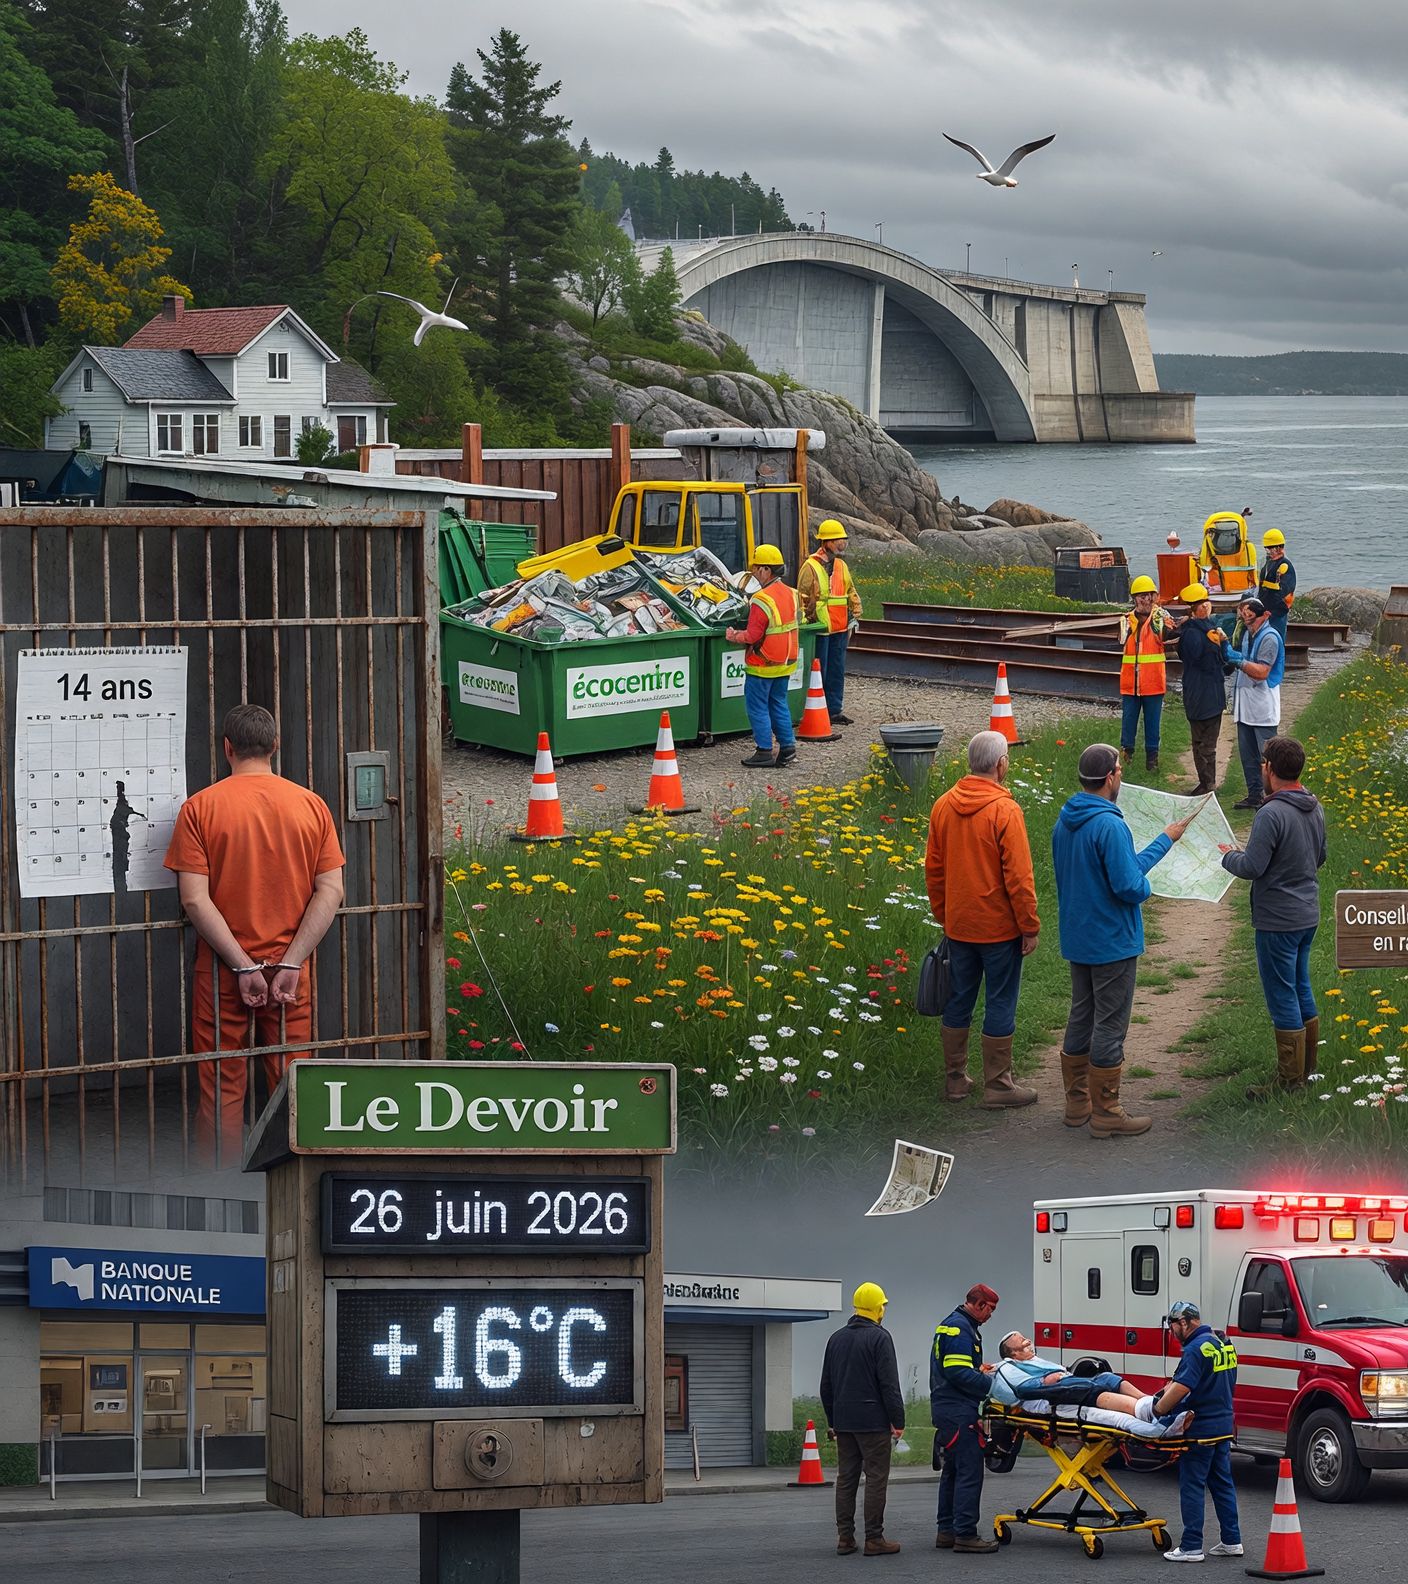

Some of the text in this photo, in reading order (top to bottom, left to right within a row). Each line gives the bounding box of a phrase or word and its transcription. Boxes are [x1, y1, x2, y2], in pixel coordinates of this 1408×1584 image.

[57, 673, 153, 701] 14 ans
[573, 664, 685, 700] écocentre
[1373, 937, 1393, 951] en
[323, 1081, 618, 1133] Le Devoir
[350, 1188, 629, 1241] 26 juin 2026
[101, 1261, 192, 1281] BANQUE
[101, 1283, 221, 1304] NATIONALE
[373, 1306, 607, 1389] +16°C
